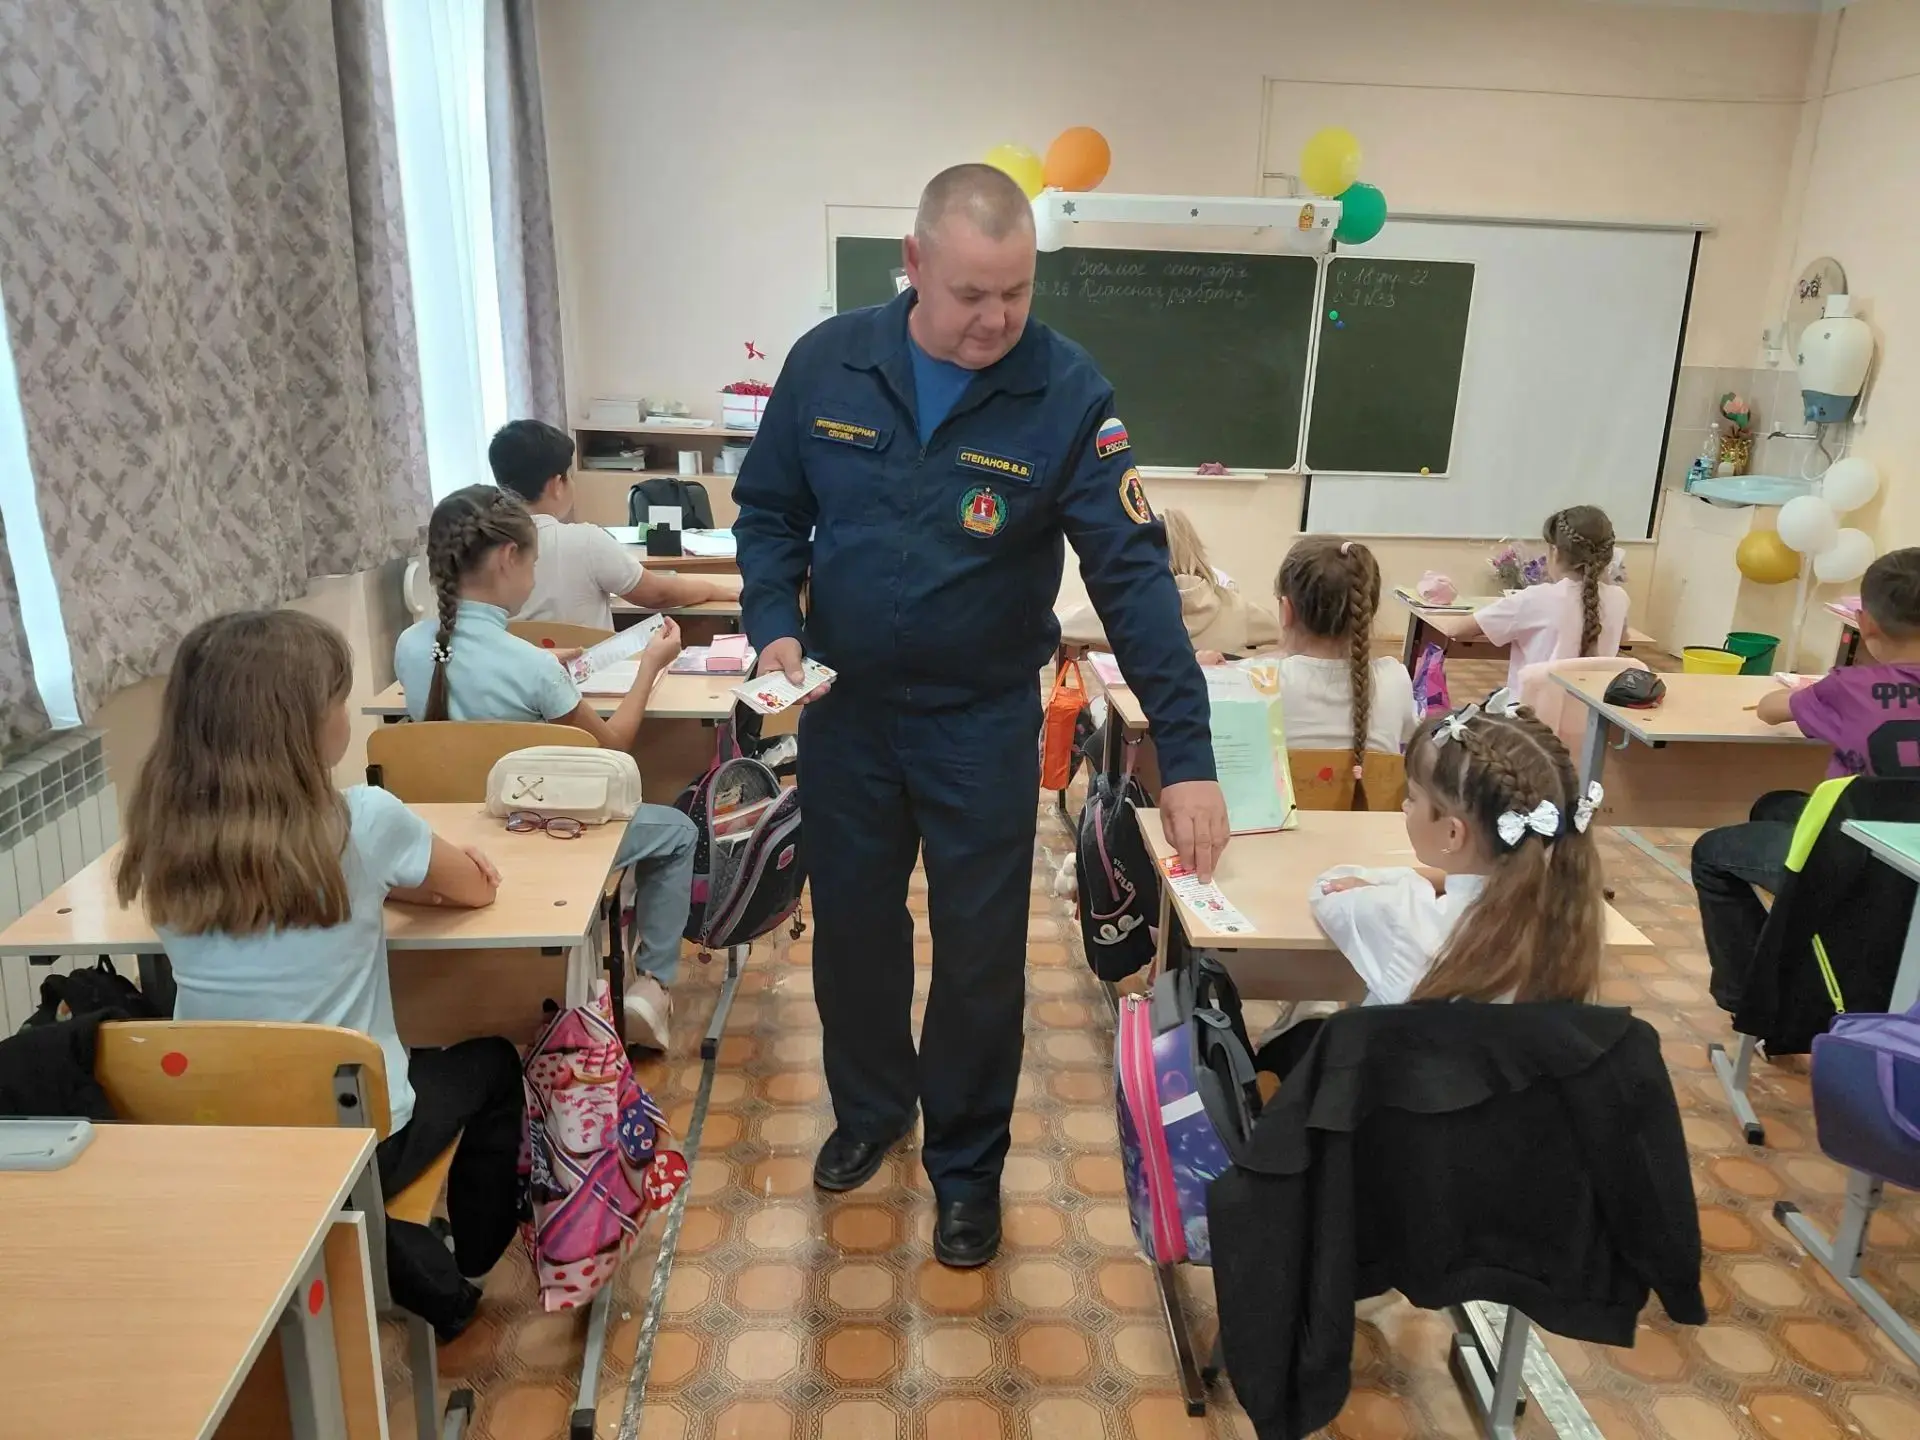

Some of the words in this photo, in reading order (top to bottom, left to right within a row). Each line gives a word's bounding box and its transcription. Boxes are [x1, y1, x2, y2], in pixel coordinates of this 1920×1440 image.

[828, 429, 854, 441] СЛУЖБА
[1105, 438, 1128, 454] РОССИ
[960, 452, 1010, 471] СТЕПАНОВ
